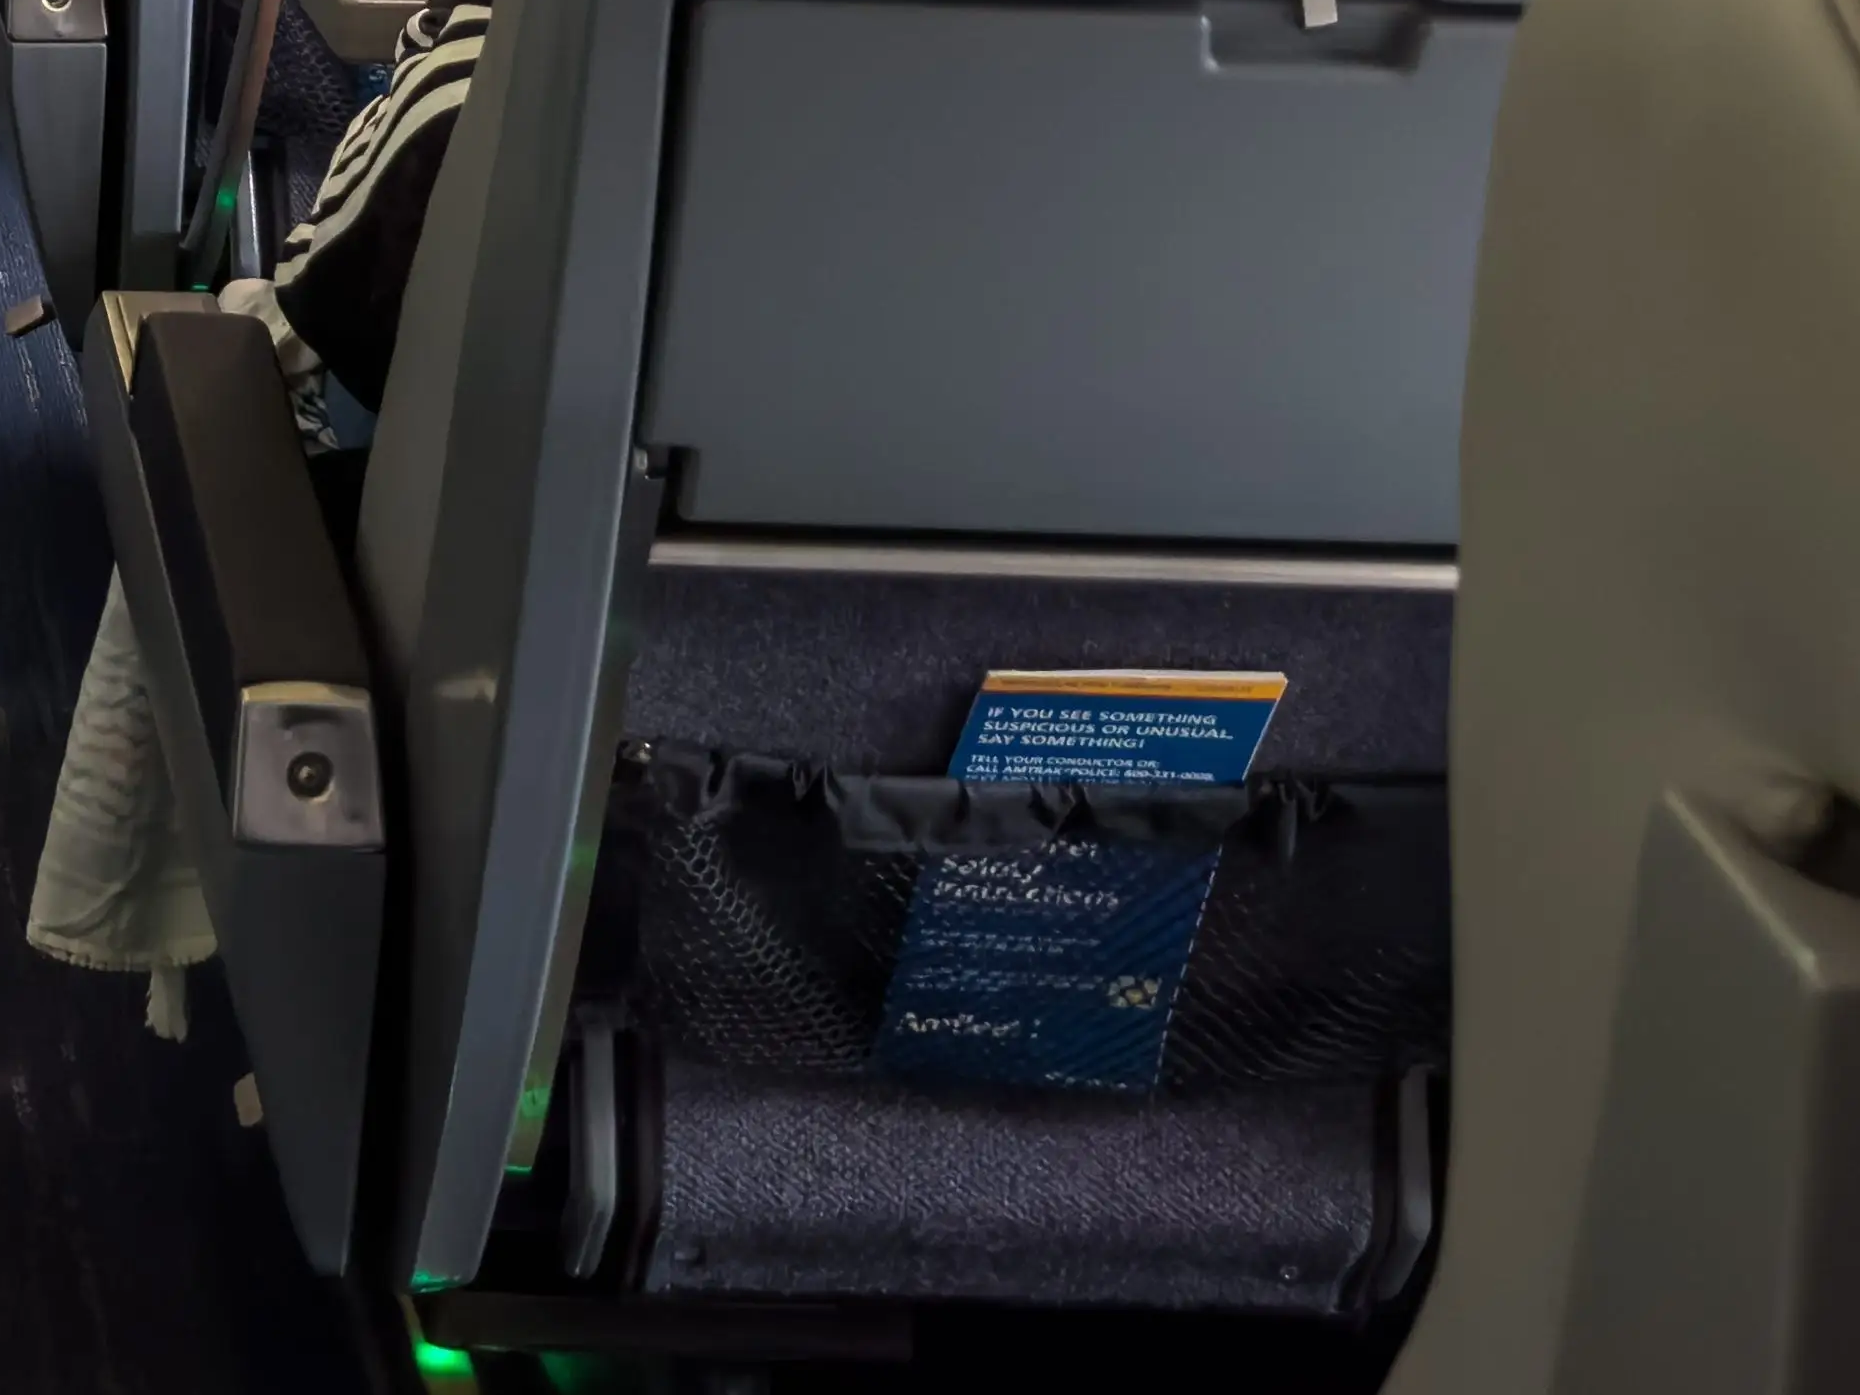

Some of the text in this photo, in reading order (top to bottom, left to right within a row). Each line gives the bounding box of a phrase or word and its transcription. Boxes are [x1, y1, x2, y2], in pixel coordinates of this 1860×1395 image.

[987, 707, 1218, 726] IF YOU SEE SOMETHING
[983, 720, 1096, 734] SUSPICIOUS
[1101, 723, 1130, 736] OR
[977, 733, 1145, 749] SAY SOMETHING!
[966, 764, 999, 774] CALL
[970, 754, 1000, 764] TELL
[1004, 755, 1045, 765] YOUR
[1046, 757, 1134, 768] CONDUCTOR
